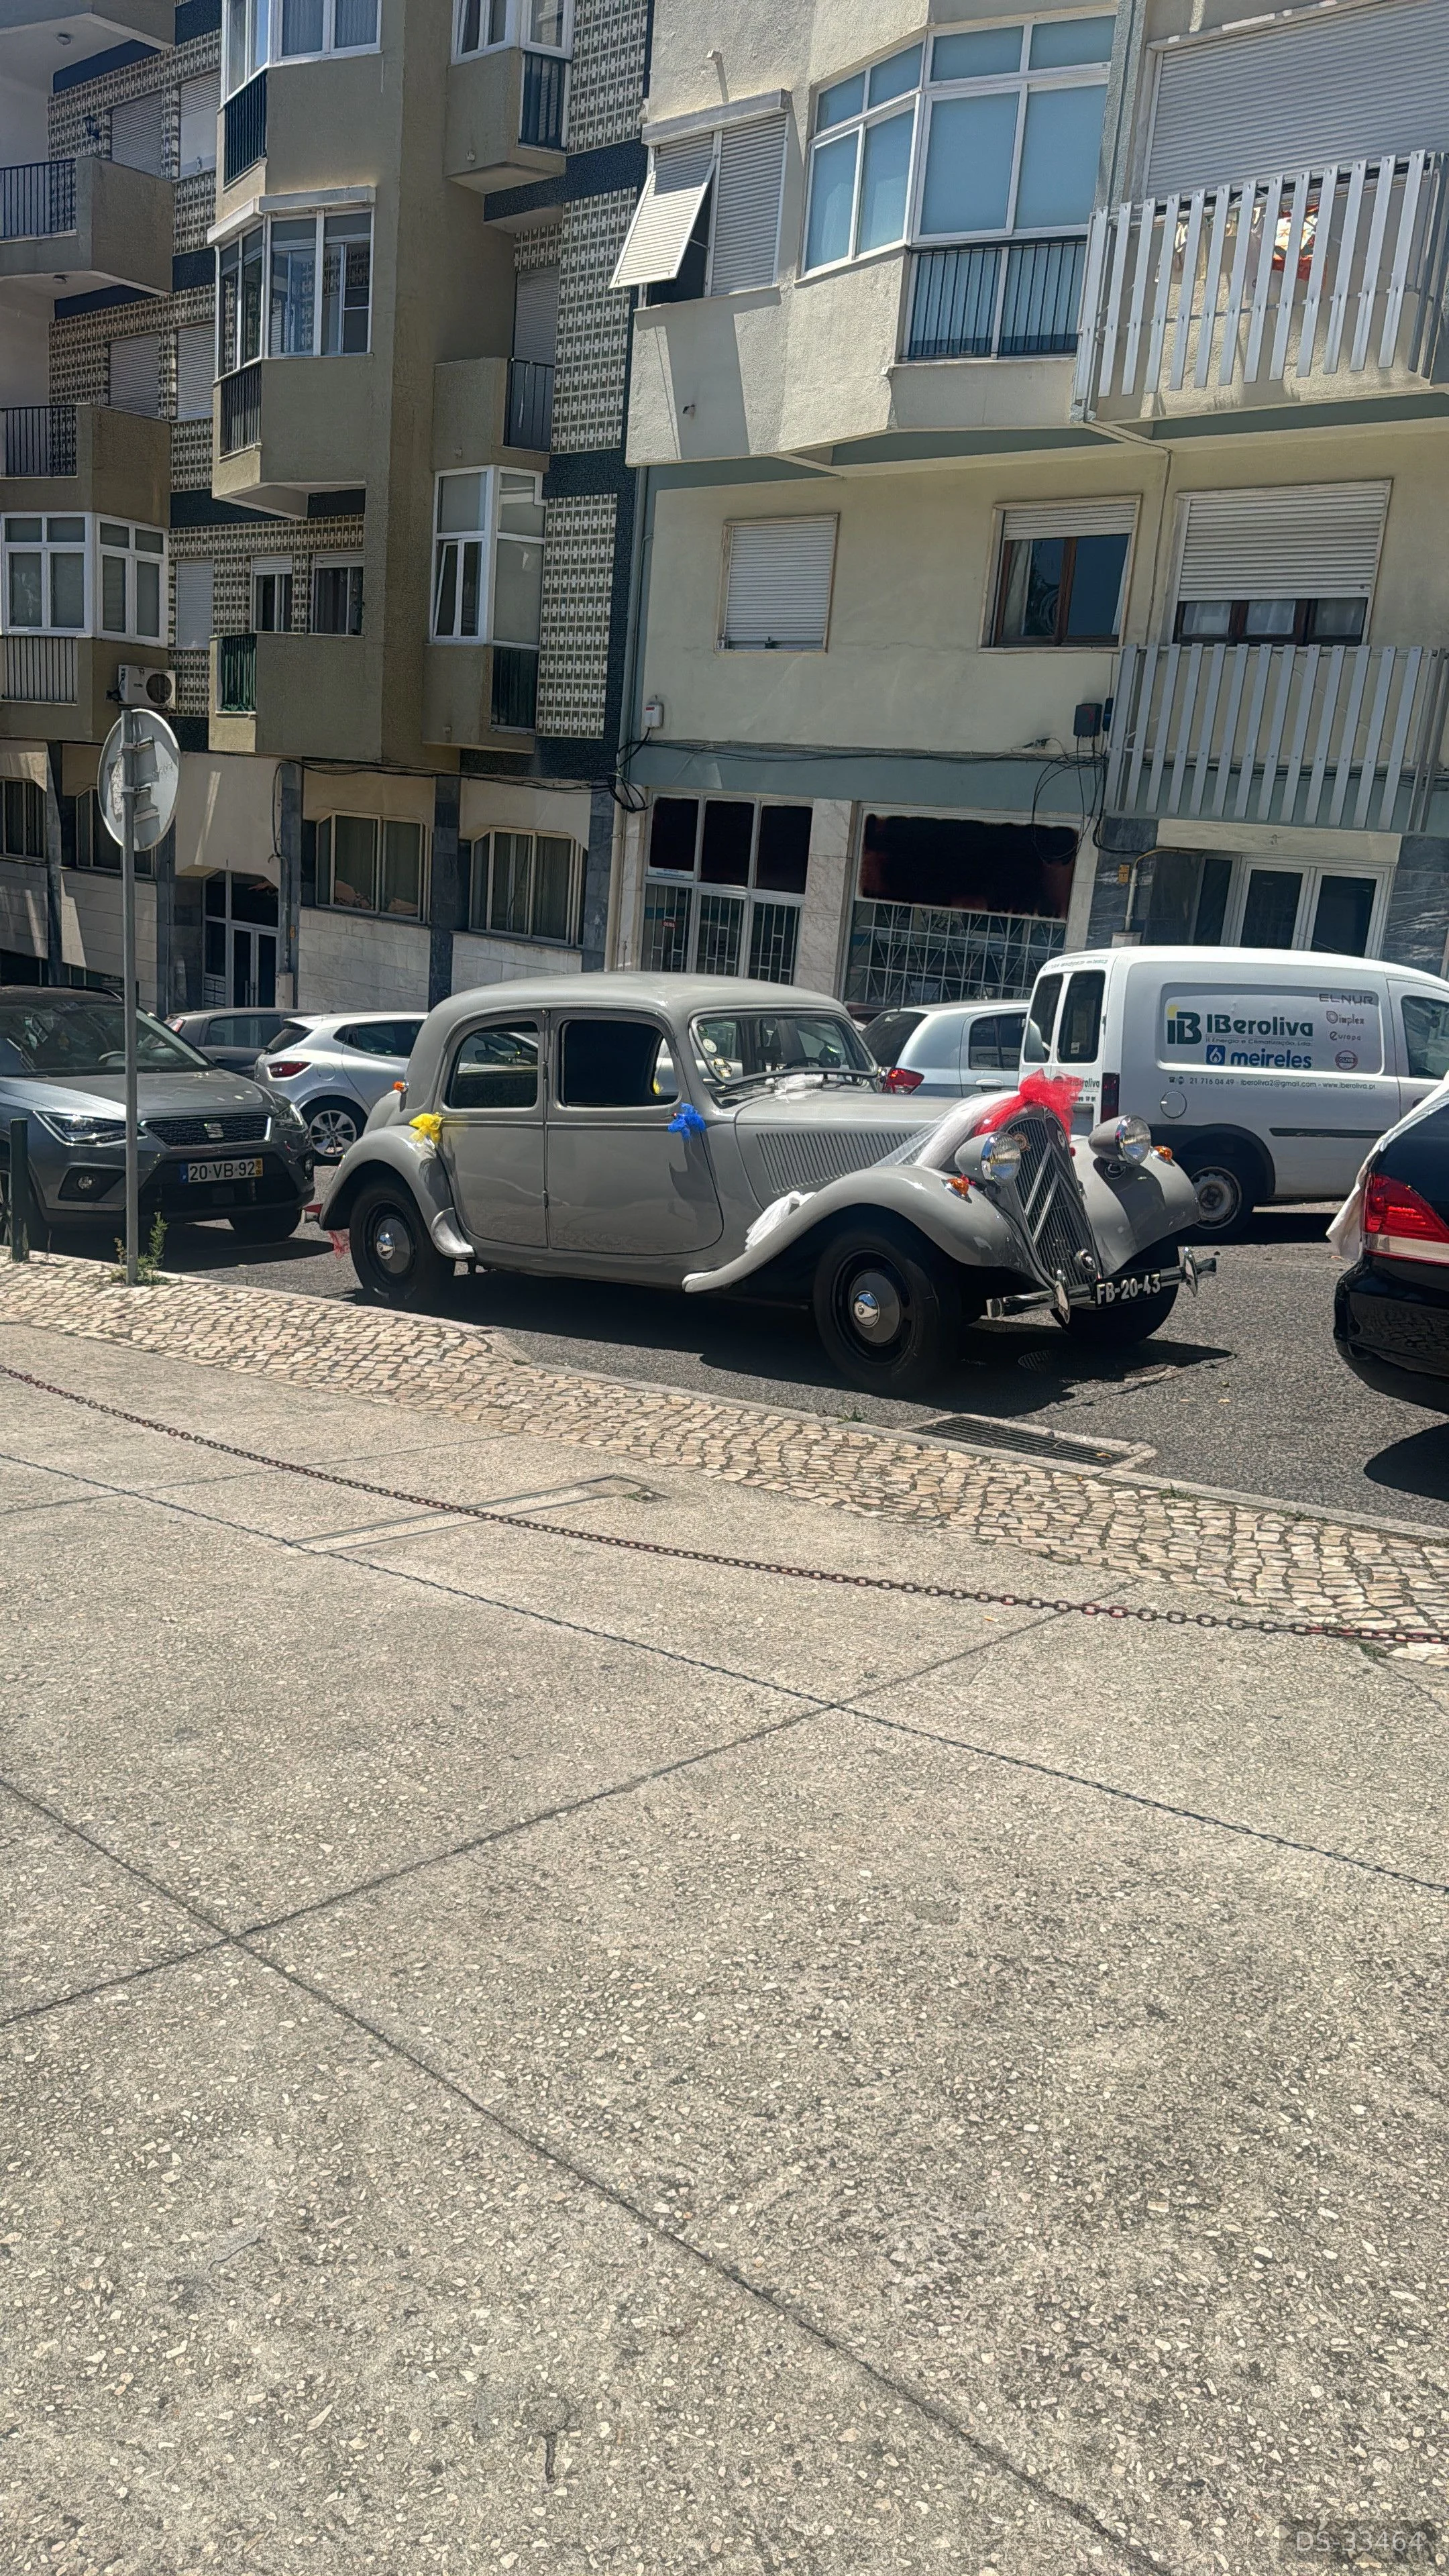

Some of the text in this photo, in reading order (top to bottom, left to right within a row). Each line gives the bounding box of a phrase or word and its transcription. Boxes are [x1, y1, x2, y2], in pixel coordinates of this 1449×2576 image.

[1319, 994, 1373, 1005] ELNUR
[1207, 1014, 1313, 1037] IBeroliva
[1326, 1010, 1364, 1026] Dimplex
[1230, 1048, 1312, 1069] meireles
[1097, 1274, 1161, 1305] FB-20-43
